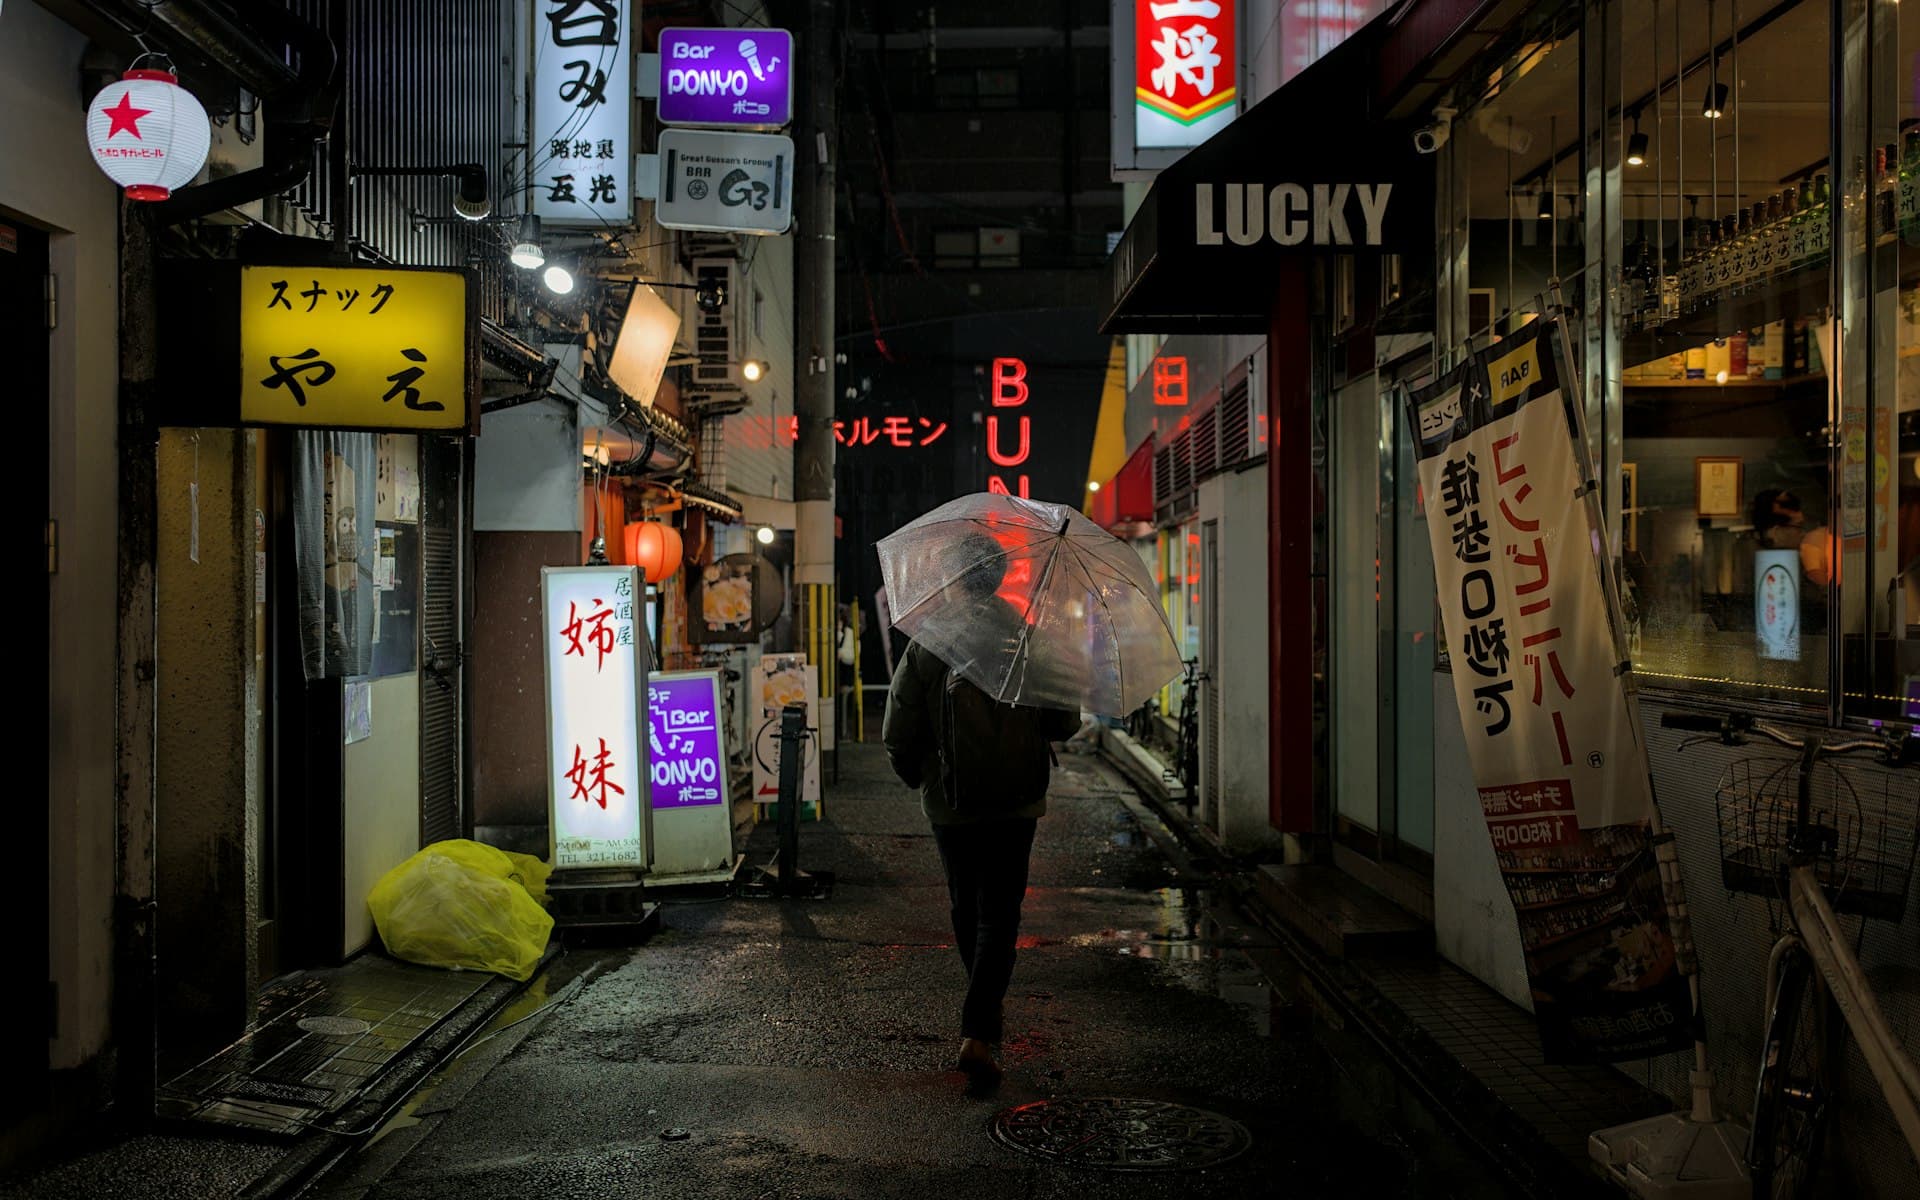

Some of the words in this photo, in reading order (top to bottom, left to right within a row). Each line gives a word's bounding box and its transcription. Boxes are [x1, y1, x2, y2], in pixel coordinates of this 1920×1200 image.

[673, 42, 716, 59] Bar
[668, 69, 749, 96] PONYO
[550, 139, 614, 160] 路地裏
[680, 154, 704, 163] Great
[686, 166, 711, 177] BAR
[1195, 182, 1393, 247] LUCKY
[266, 280, 395, 314] スナック
[261, 348, 445, 412] やえ
[614, 577, 636, 647] 居酒屋
[560, 599, 625, 811] 姉妹
[671, 709, 709, 726] Bar
[650, 757, 716, 786] ONYO
[560, 853, 579, 864] TEL
